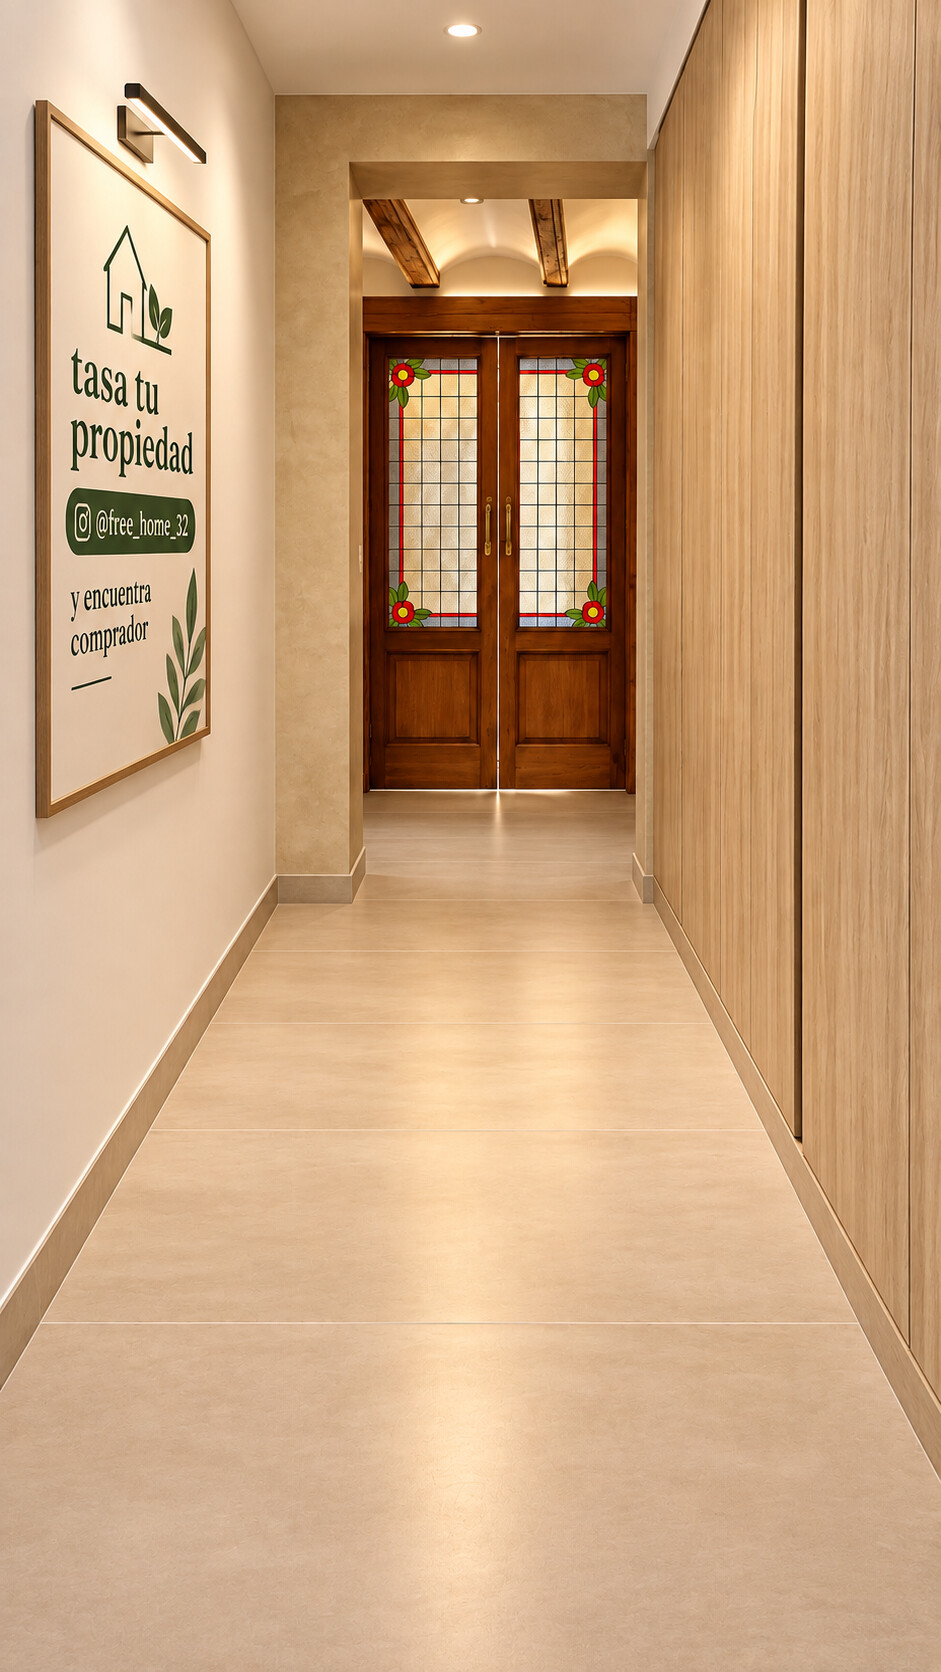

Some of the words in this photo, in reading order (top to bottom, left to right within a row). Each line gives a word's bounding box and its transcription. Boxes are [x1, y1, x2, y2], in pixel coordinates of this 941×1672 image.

[70, 347, 128, 408] tasa
[134, 370, 159, 416] tu
[70, 418, 194, 478] propiedad
[95, 508, 189, 540] @free_home_32
[70, 590, 80, 622] y
[83, 581, 152, 611] encuentra
[70, 614, 149, 658] comprador
